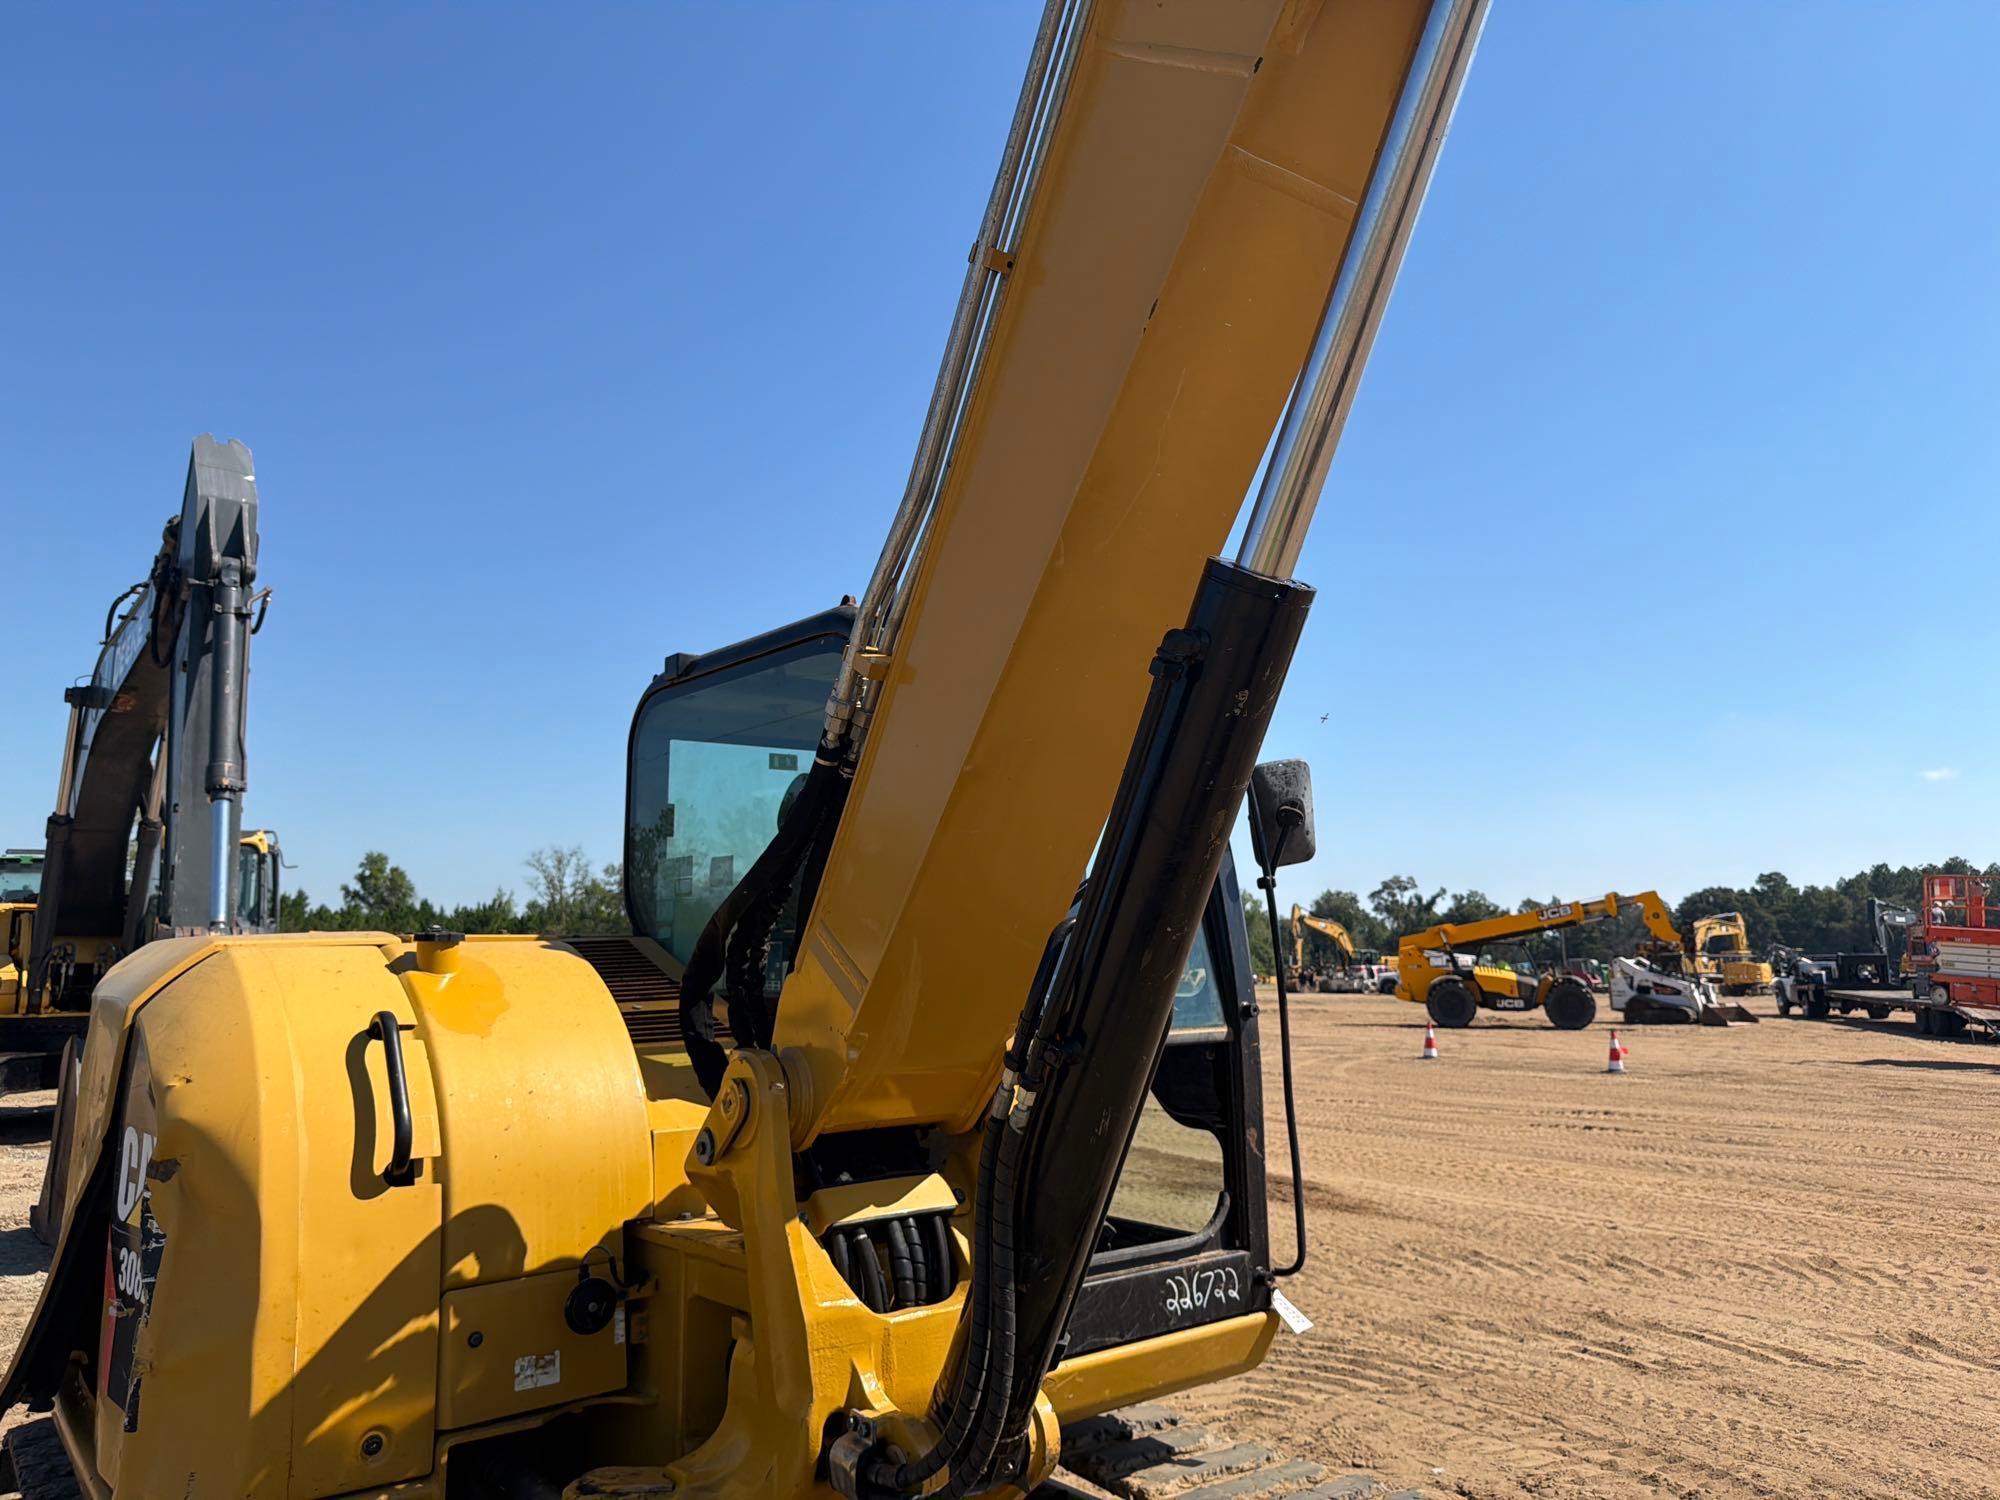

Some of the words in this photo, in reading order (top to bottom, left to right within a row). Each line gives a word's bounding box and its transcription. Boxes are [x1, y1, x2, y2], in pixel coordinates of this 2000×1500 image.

[1539, 905, 1572, 921] JCB
[1496, 999, 1525, 1008] JCB
[117, 1126, 157, 1222] CA
[1166, 1267, 1240, 1316] 226722
